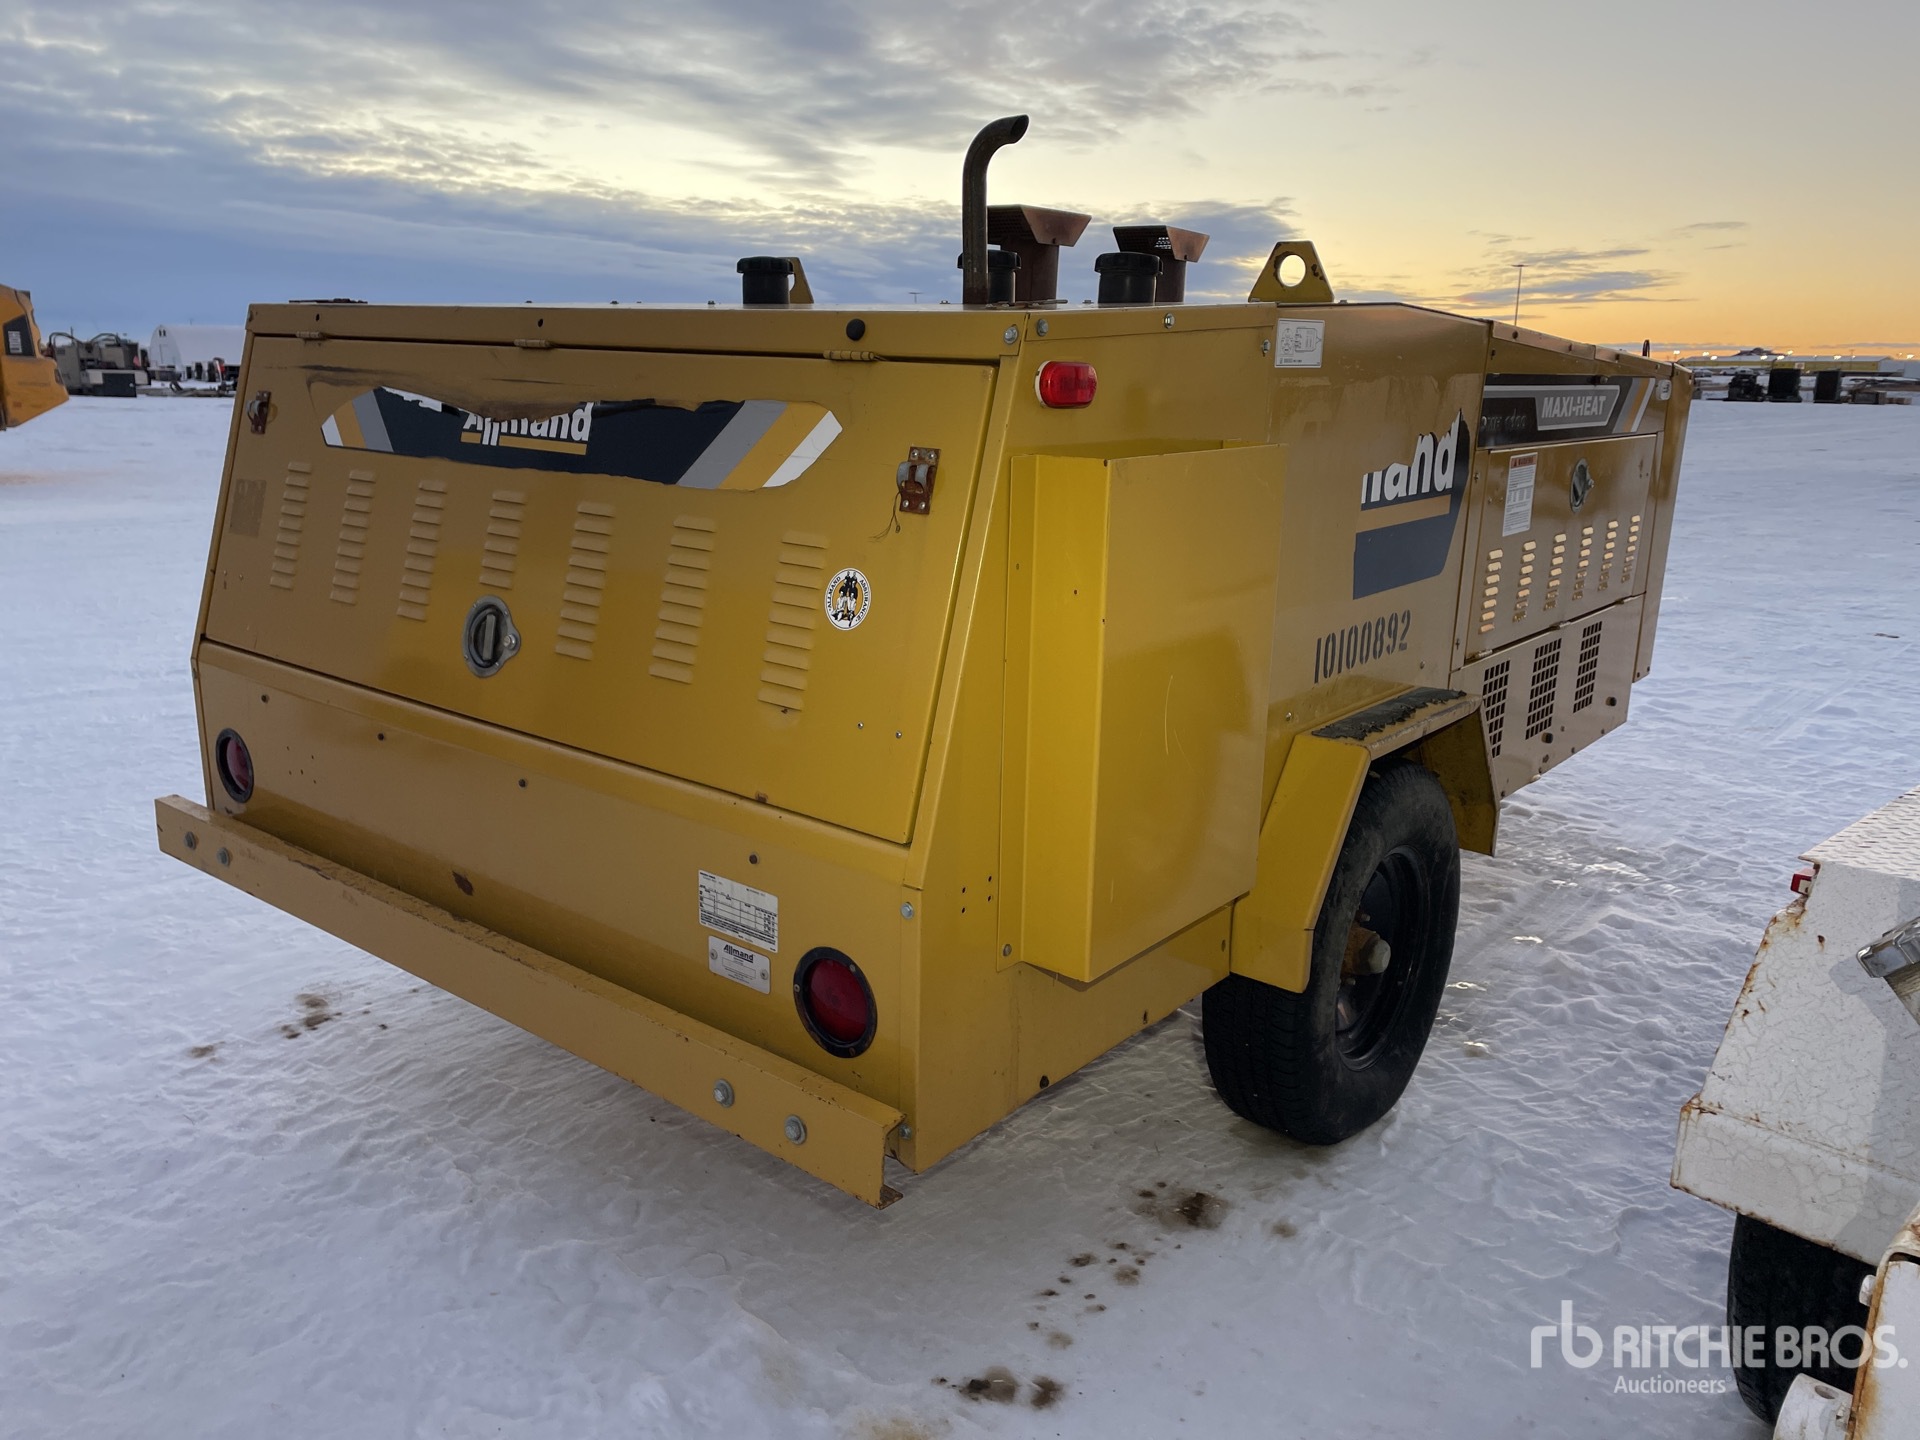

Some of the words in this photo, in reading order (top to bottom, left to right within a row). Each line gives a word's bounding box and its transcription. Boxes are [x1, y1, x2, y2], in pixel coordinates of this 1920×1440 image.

[1541, 395, 1607, 418] MAXI-HEAT
[1314, 609, 1411, 685] 10100892
[723, 944, 754, 961] Allmand
